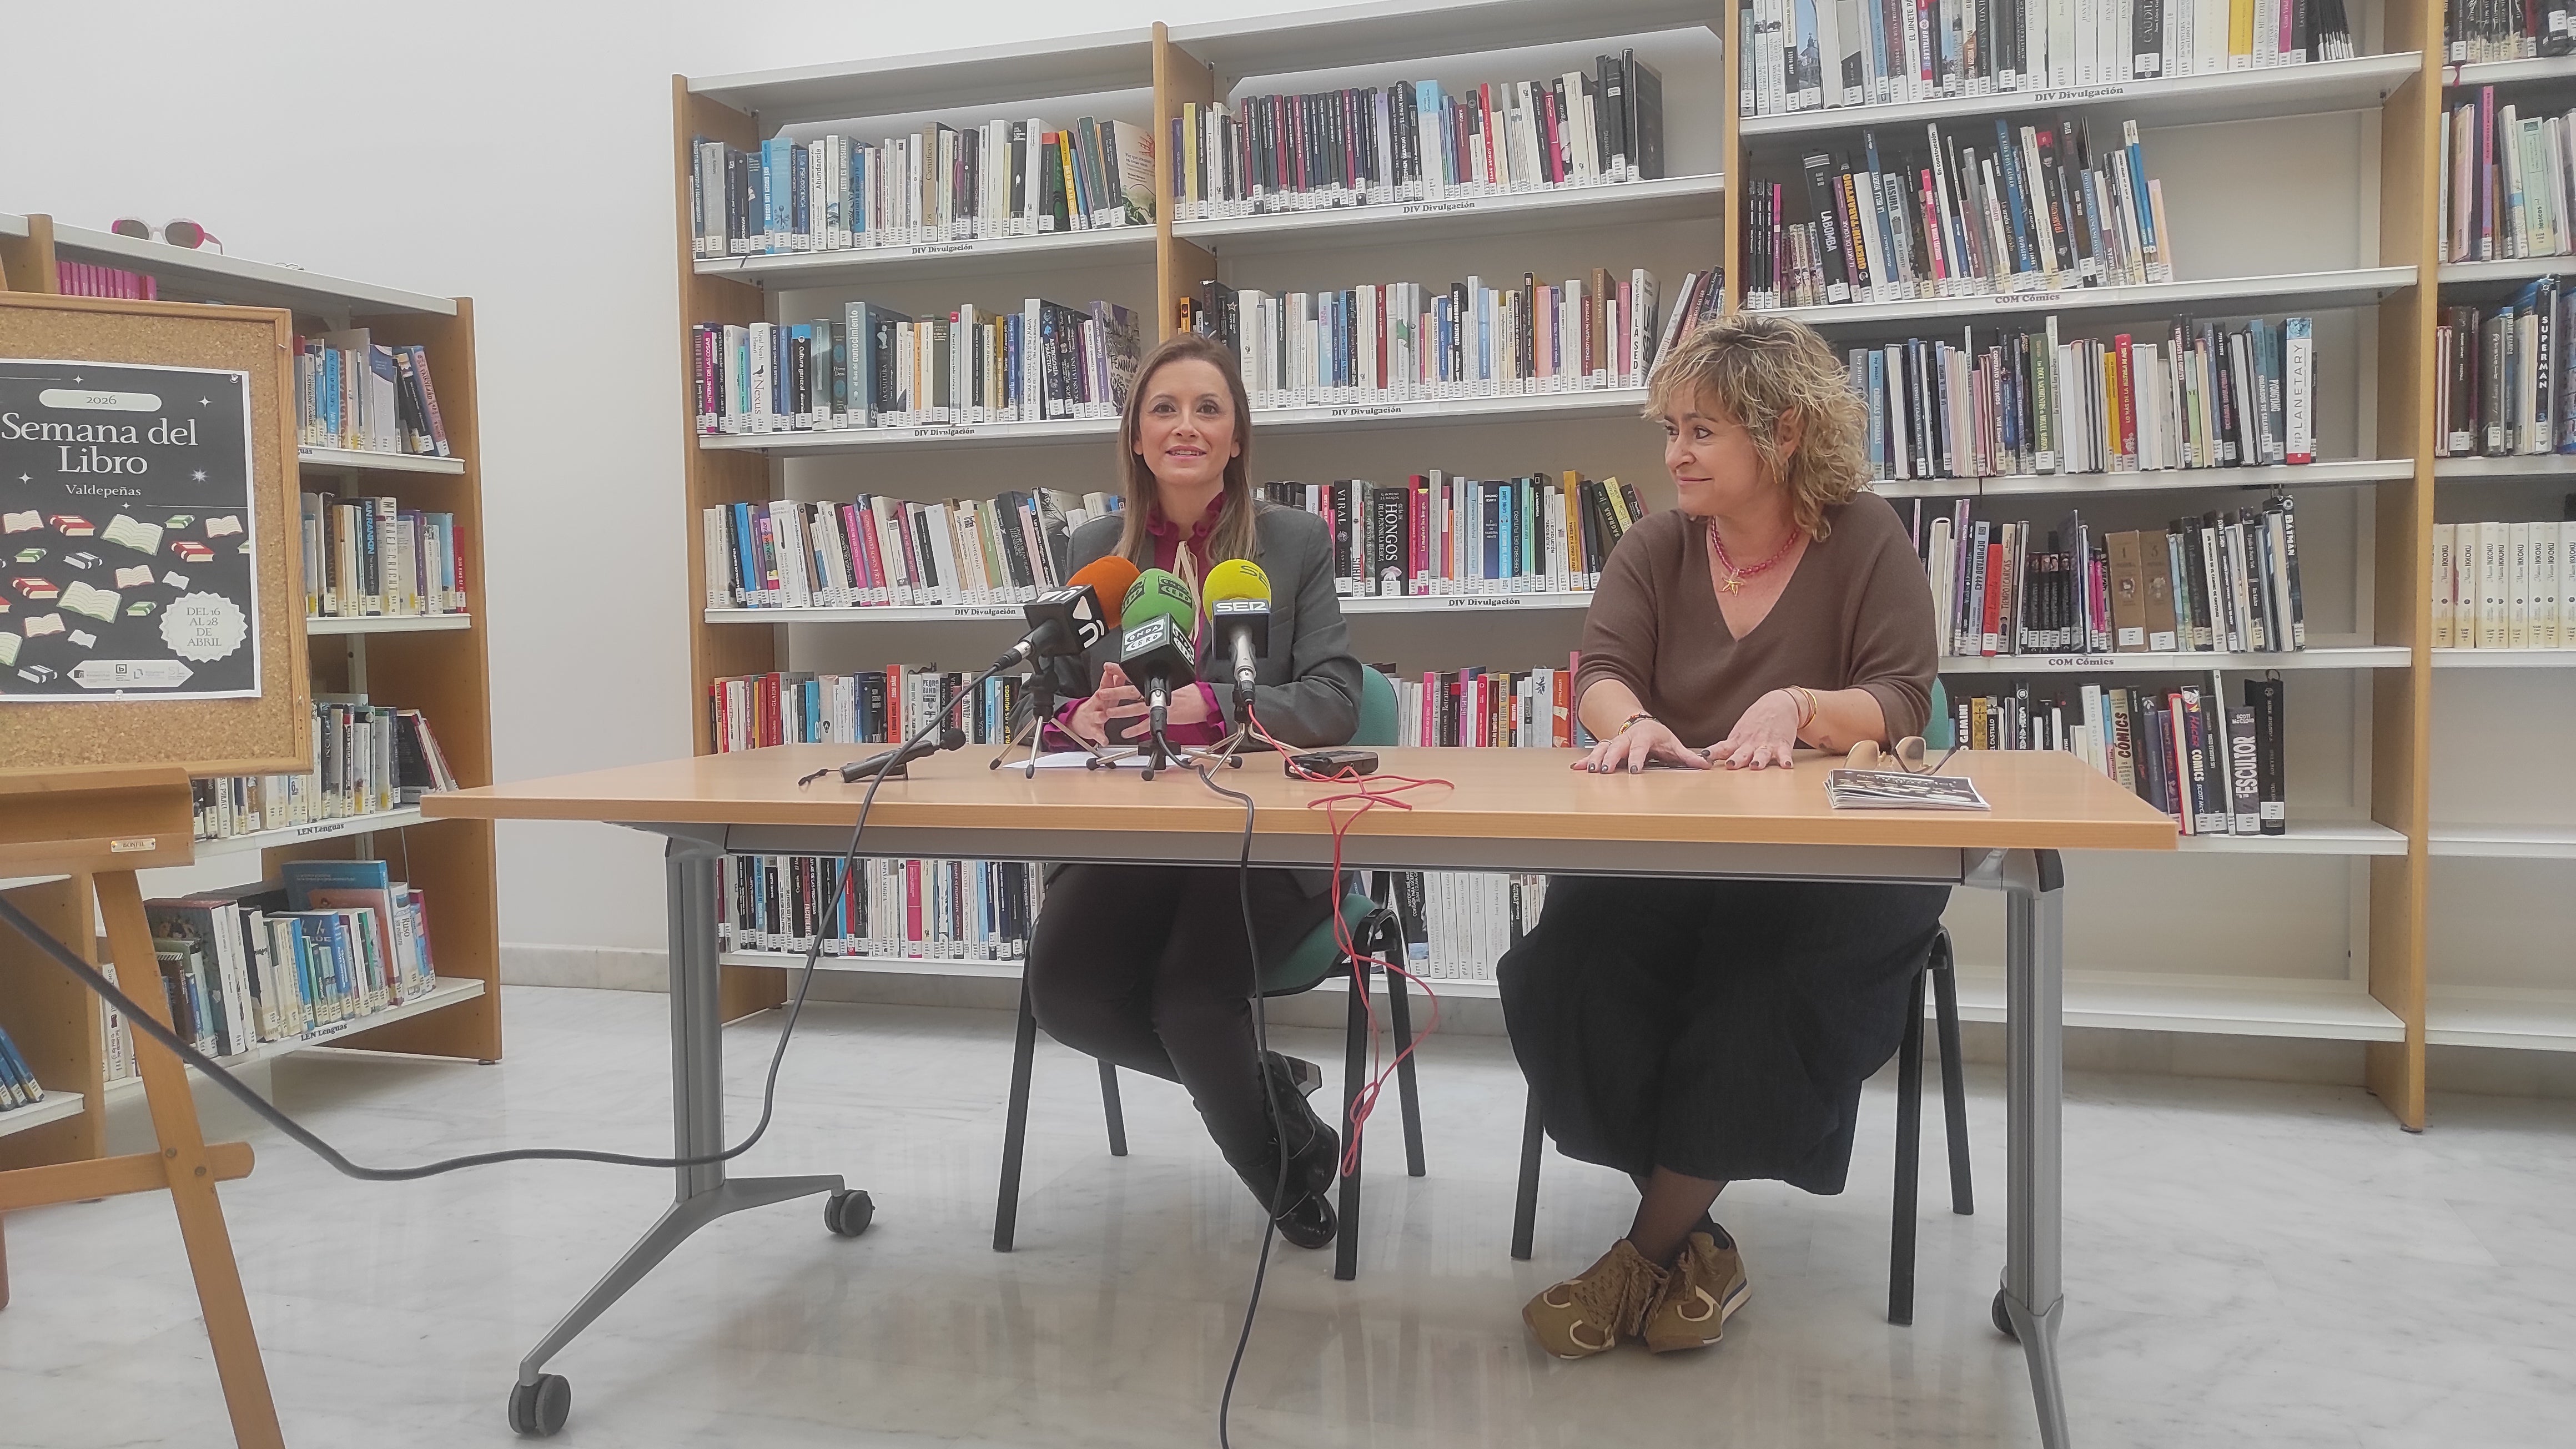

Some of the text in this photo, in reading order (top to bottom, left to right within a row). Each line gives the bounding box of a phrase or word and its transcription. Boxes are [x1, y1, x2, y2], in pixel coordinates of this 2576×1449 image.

[1909, 32, 1915, 41] EL
[2035, 86, 2124, 102] DIV Divulgación
[1886, 179, 1899, 211] BASURA
[1403, 202, 1476, 214] DIV Divulgación
[928, 244, 973, 254] Divulgación
[1995, 293, 2060, 304] COM Cómics
[2538, 316, 2549, 389] SUPERMAN
[87, 395, 117, 405] 2026
[754, 379, 764, 414] Nexus
[2293, 344, 2303, 442] PLANETARY
[1350, 406, 1401, 415] Divulgación
[1, 412, 199, 446] Semana del
[930, 427, 975, 436] Divulgación
[57, 446, 148, 475] Libro
[66, 484, 142, 498] Valdepeñas
[1337, 489, 1346, 525] VIRAL
[365, 517, 375, 555] RANKIN
[1385, 502, 1398, 561] HONGOS
[2284, 514, 2295, 556] BATMAN
[1976, 540, 1985, 576] DEPORTADO
[387, 554, 398, 591] CRICHT
[187, 607, 209, 616] DEL
[1216, 602, 1267, 612] SER
[189, 617, 218, 626] AL 28
[196, 628, 212, 636] DE
[1130, 626, 1159, 640] ONDA
[187, 638, 222, 646] ABRIL
[1131, 634, 1158, 648] CERO
[2076, 657, 2114, 666] Cómics
[2115, 712, 2131, 758] CÓMICS
[2232, 736, 2258, 793] ESCULTOR
[297, 823, 344, 836] LEN Lenguas
[301, 1023, 348, 1042] LEN Lenguas
